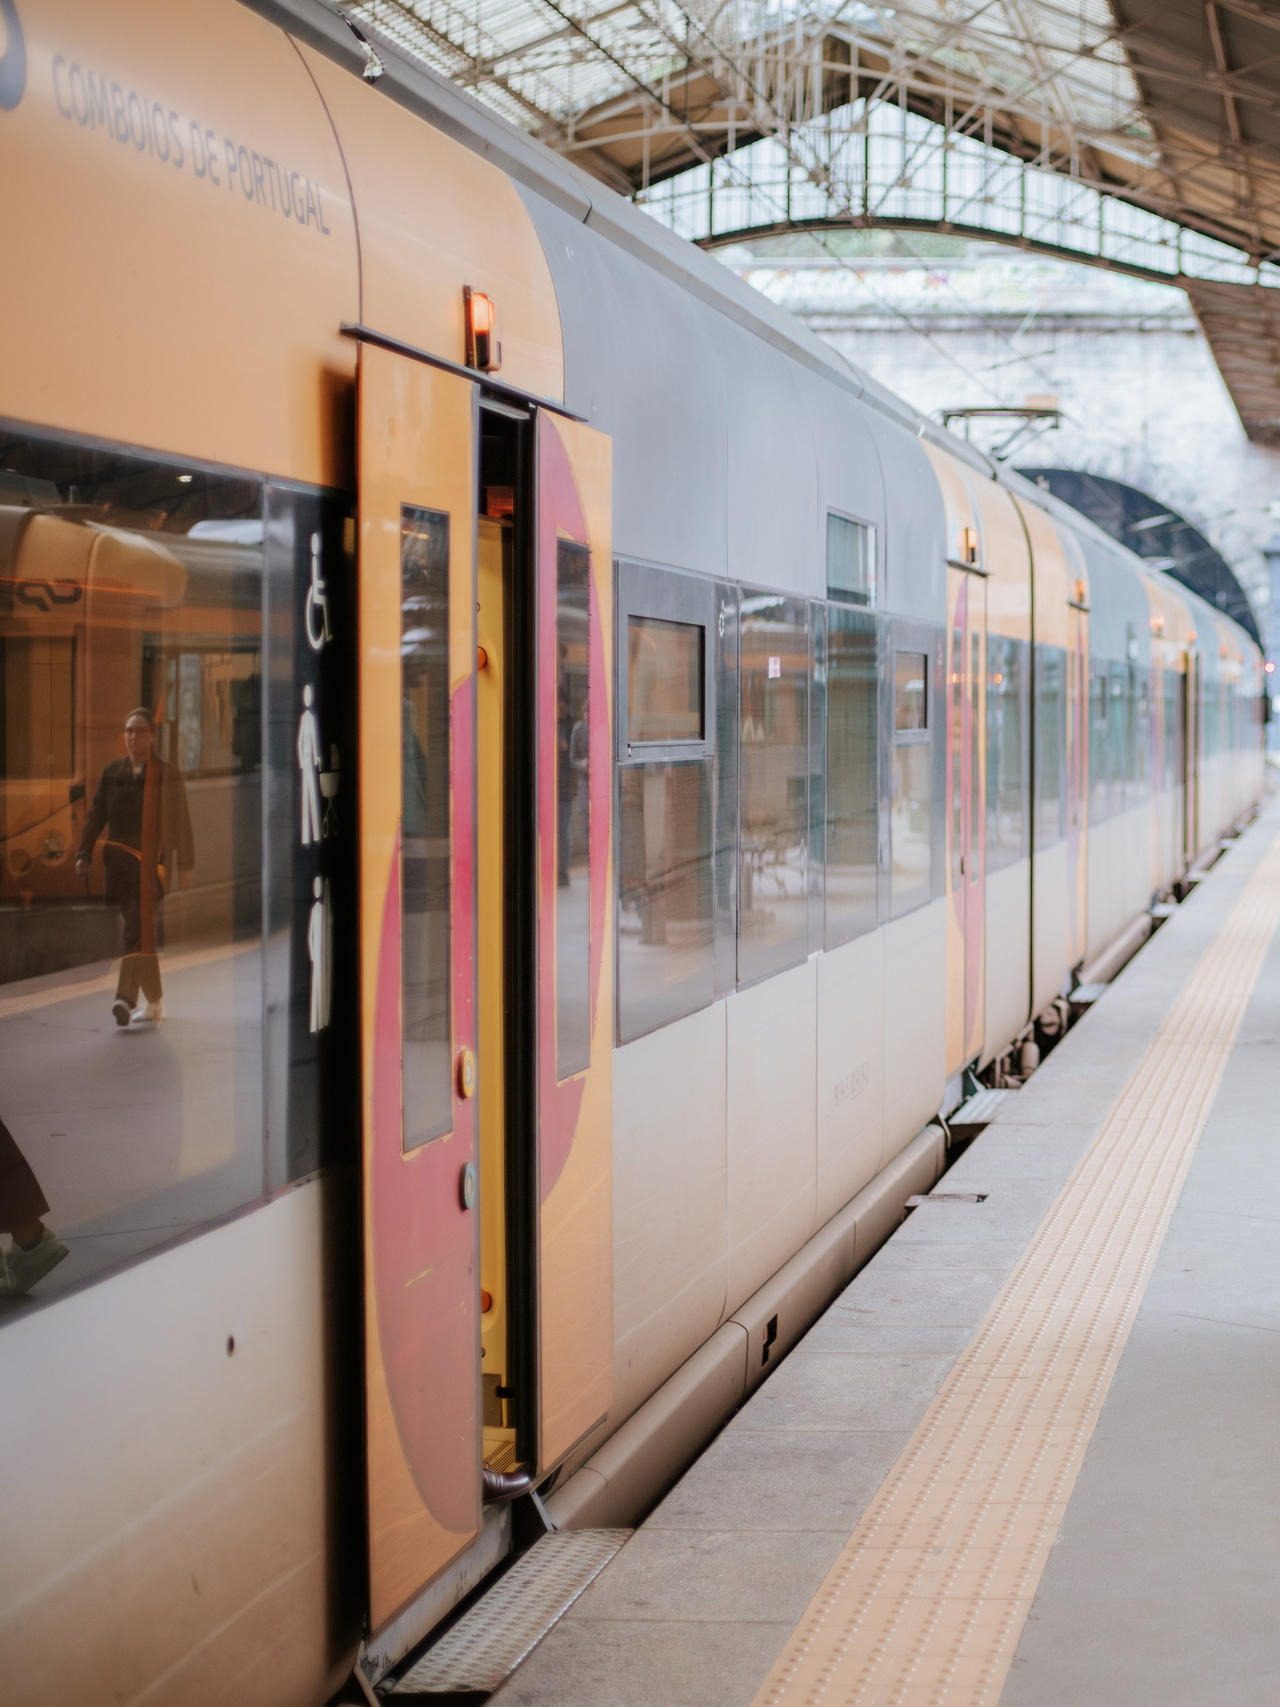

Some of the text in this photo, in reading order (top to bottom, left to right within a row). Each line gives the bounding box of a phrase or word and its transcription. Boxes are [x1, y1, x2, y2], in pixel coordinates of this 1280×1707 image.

[52, 53, 330, 236] COMBOIOS DE PORTUGAL
